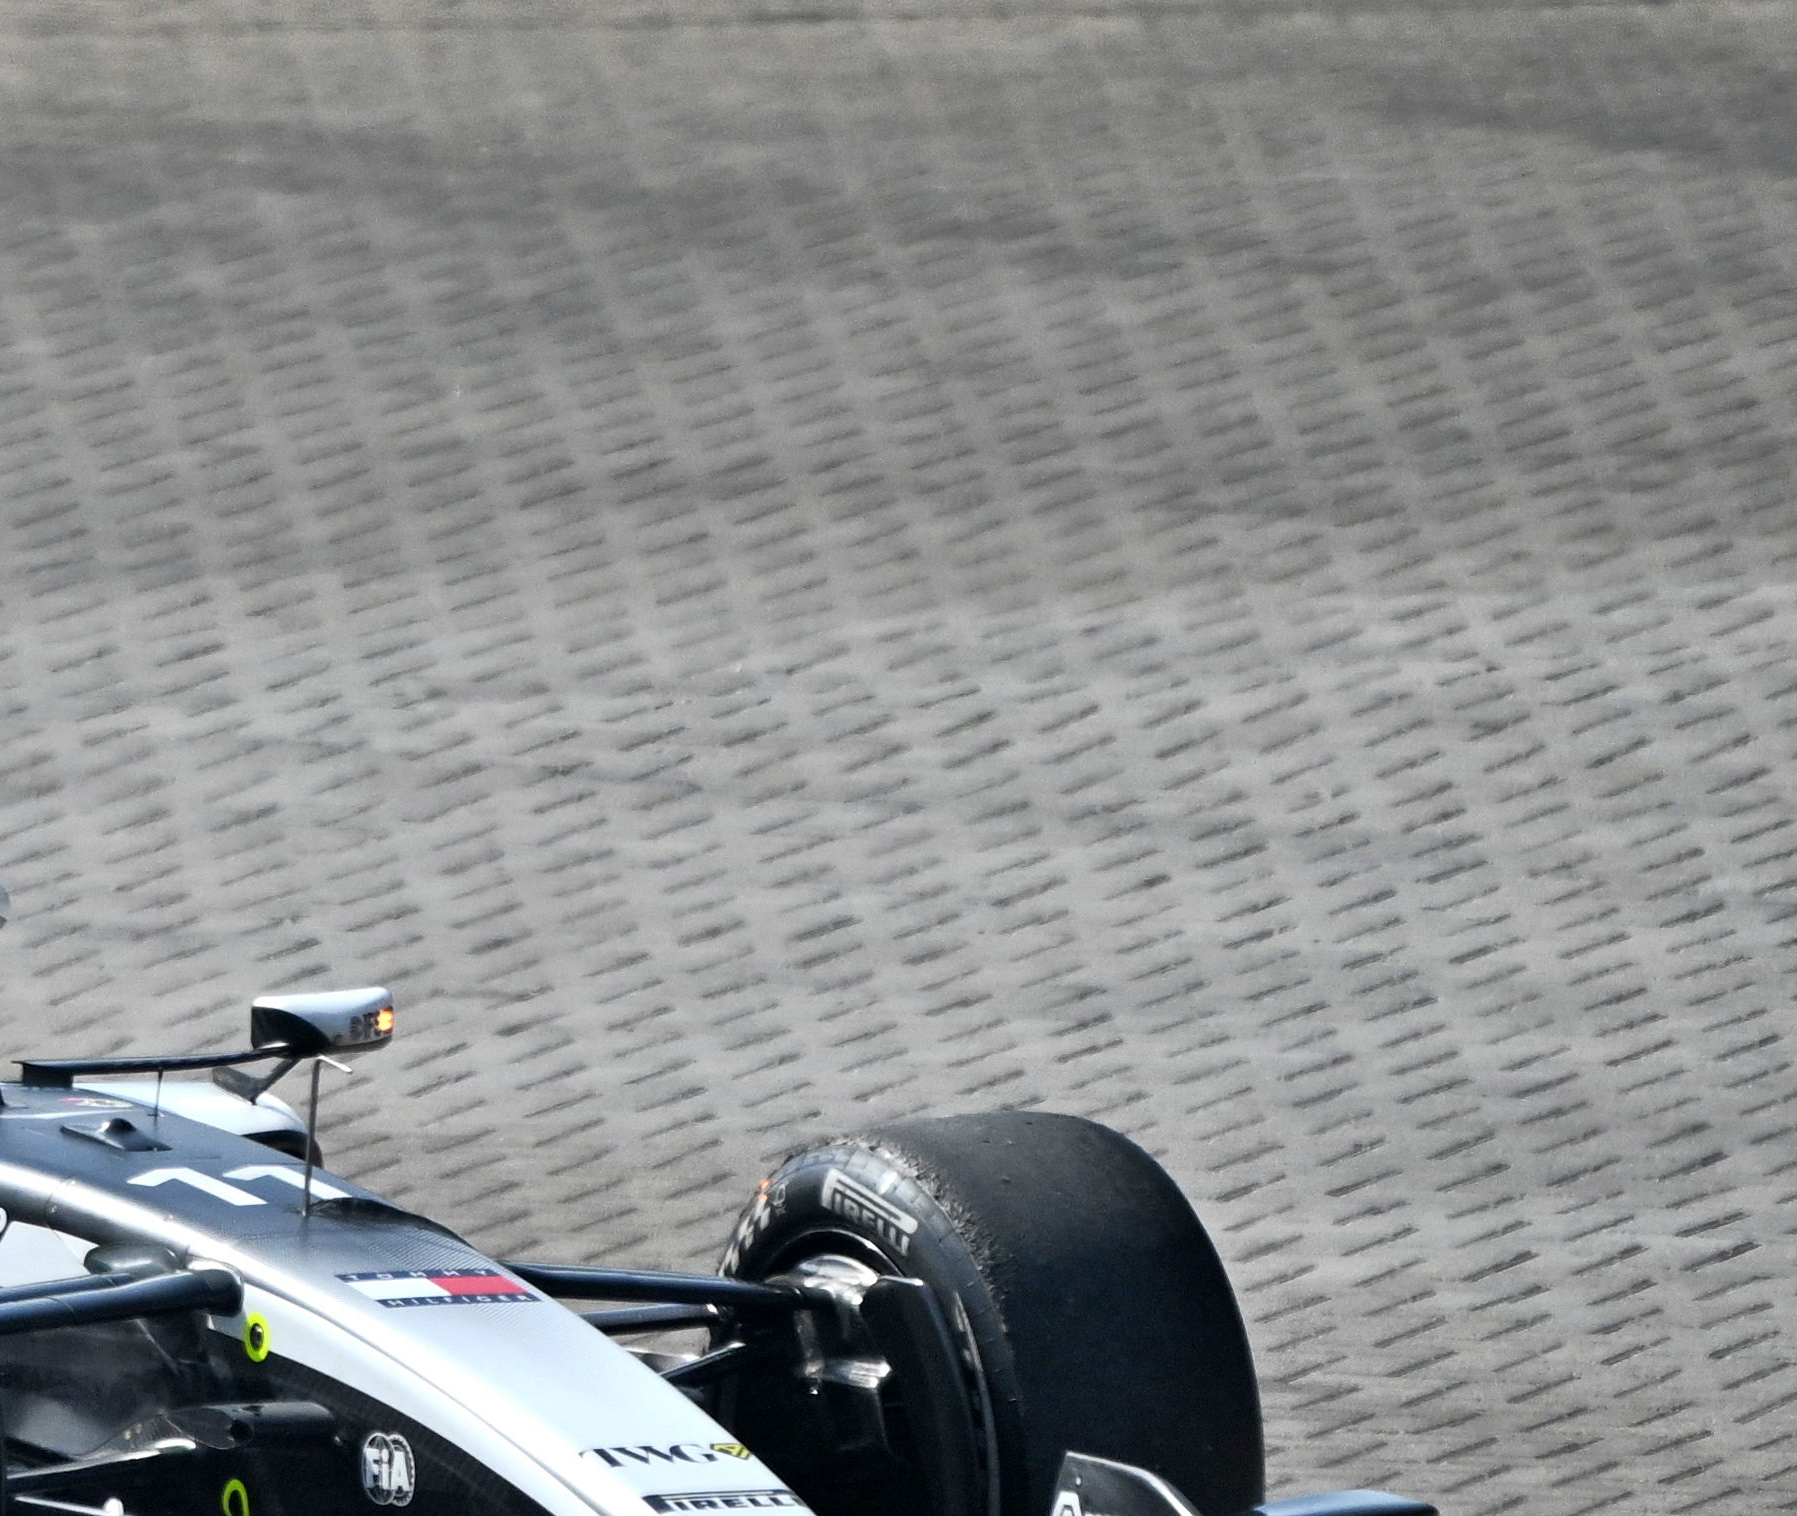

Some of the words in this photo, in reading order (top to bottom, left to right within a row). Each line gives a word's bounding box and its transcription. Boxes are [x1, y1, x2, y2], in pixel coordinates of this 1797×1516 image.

[821, 1168, 918, 1257] PIRELLI
[348, 1269, 491, 1280] TOMMY
[387, 1294, 534, 1307] HILFIGER
[579, 1443, 719, 1467] TWG
[365, 1462, 409, 1491] FIA
